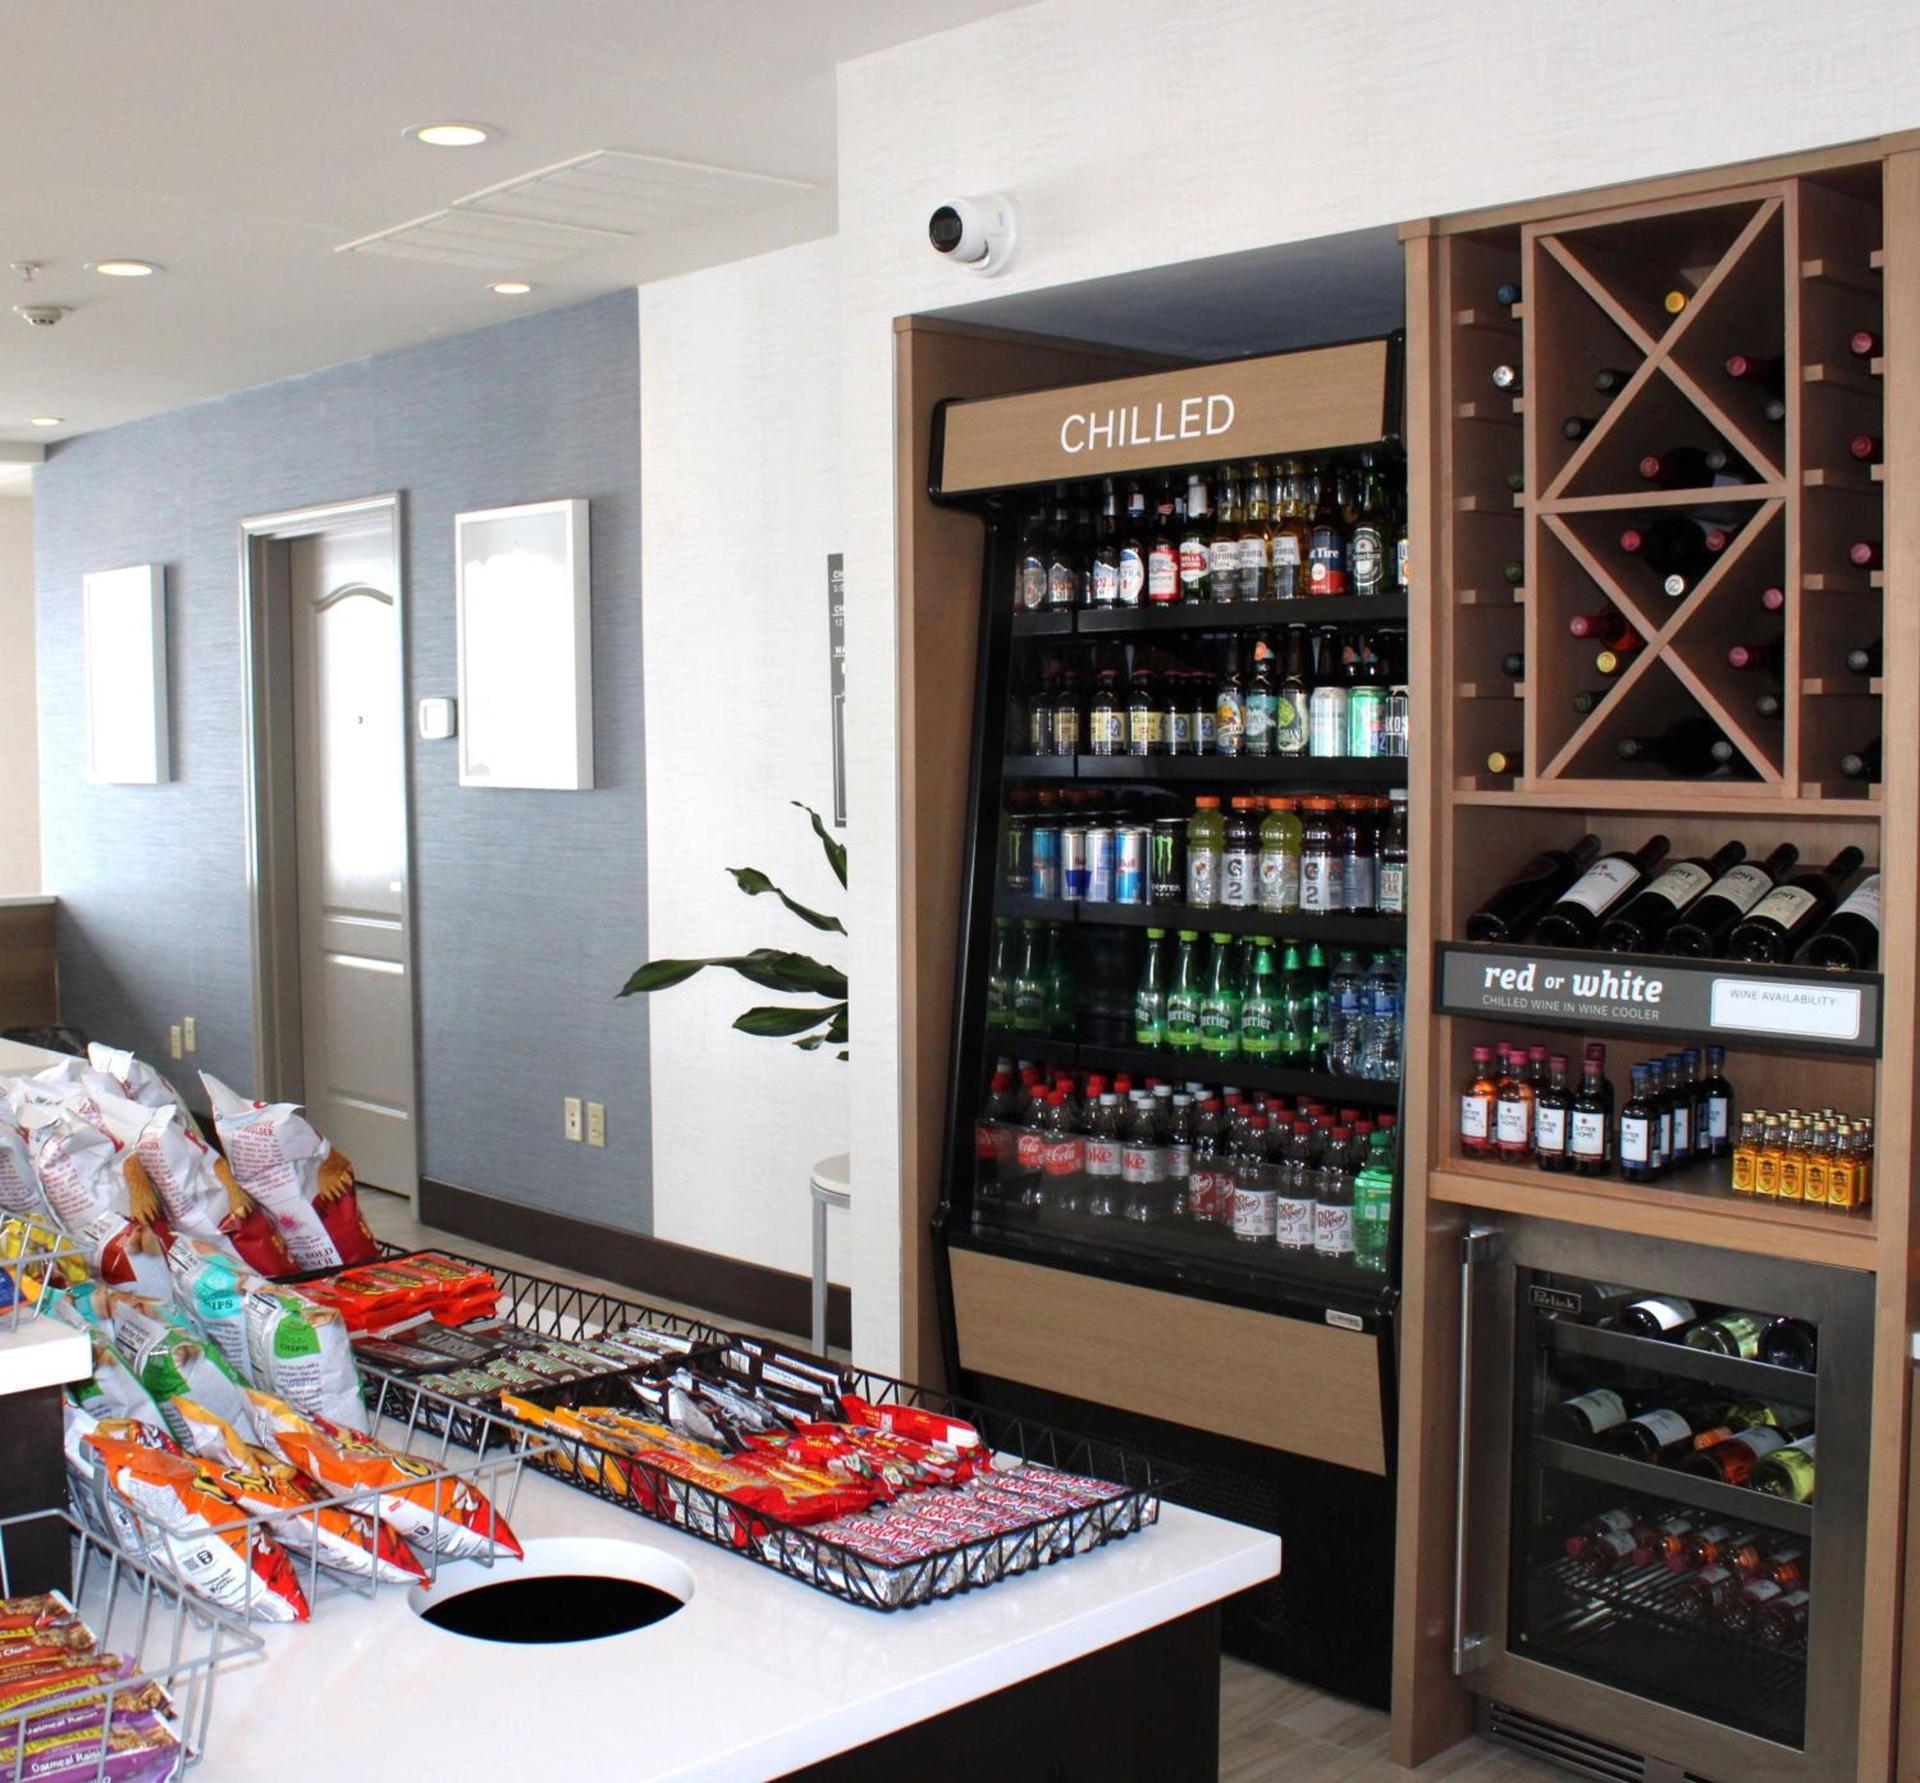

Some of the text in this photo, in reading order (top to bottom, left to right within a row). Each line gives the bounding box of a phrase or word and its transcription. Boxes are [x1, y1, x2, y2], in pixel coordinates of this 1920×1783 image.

[1060, 394, 1235, 453] CHILLED
[1484, 963, 1663, 1003] red or white
[1482, 994, 1660, 1020] CHILLED WINE IN WINE COOLER
[1730, 989, 1837, 1006] WINE AVAILABILITY
[4, 1645, 31, 1657] Chunk
[32, 1755, 74, 1773] Oatmeal
